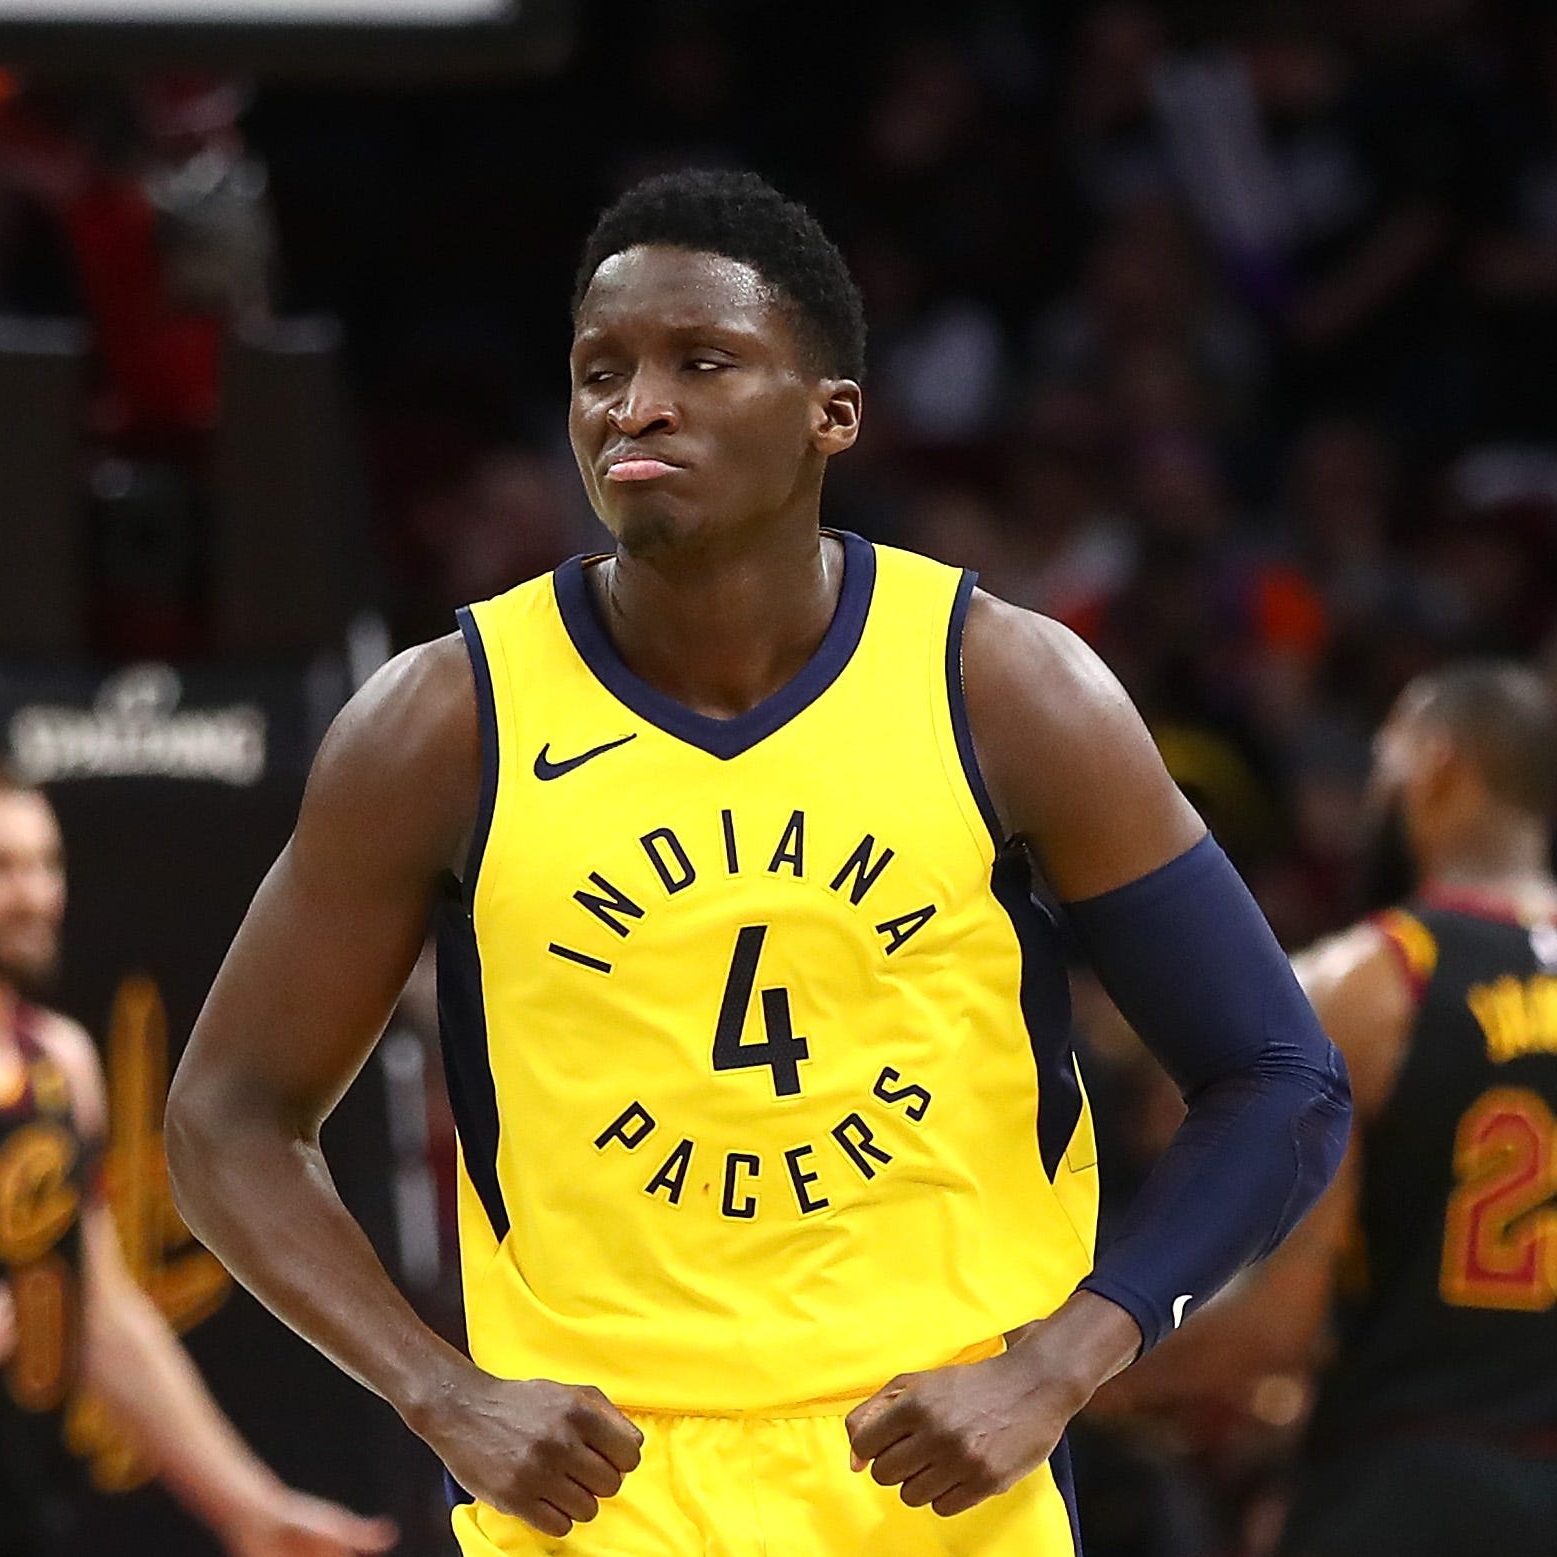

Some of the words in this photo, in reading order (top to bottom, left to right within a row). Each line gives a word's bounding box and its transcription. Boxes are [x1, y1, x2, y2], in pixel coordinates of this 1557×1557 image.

[547, 808, 937, 975] INDIANA
[711, 924, 810, 1097] 4
[593, 1064, 932, 1220] PACERS
